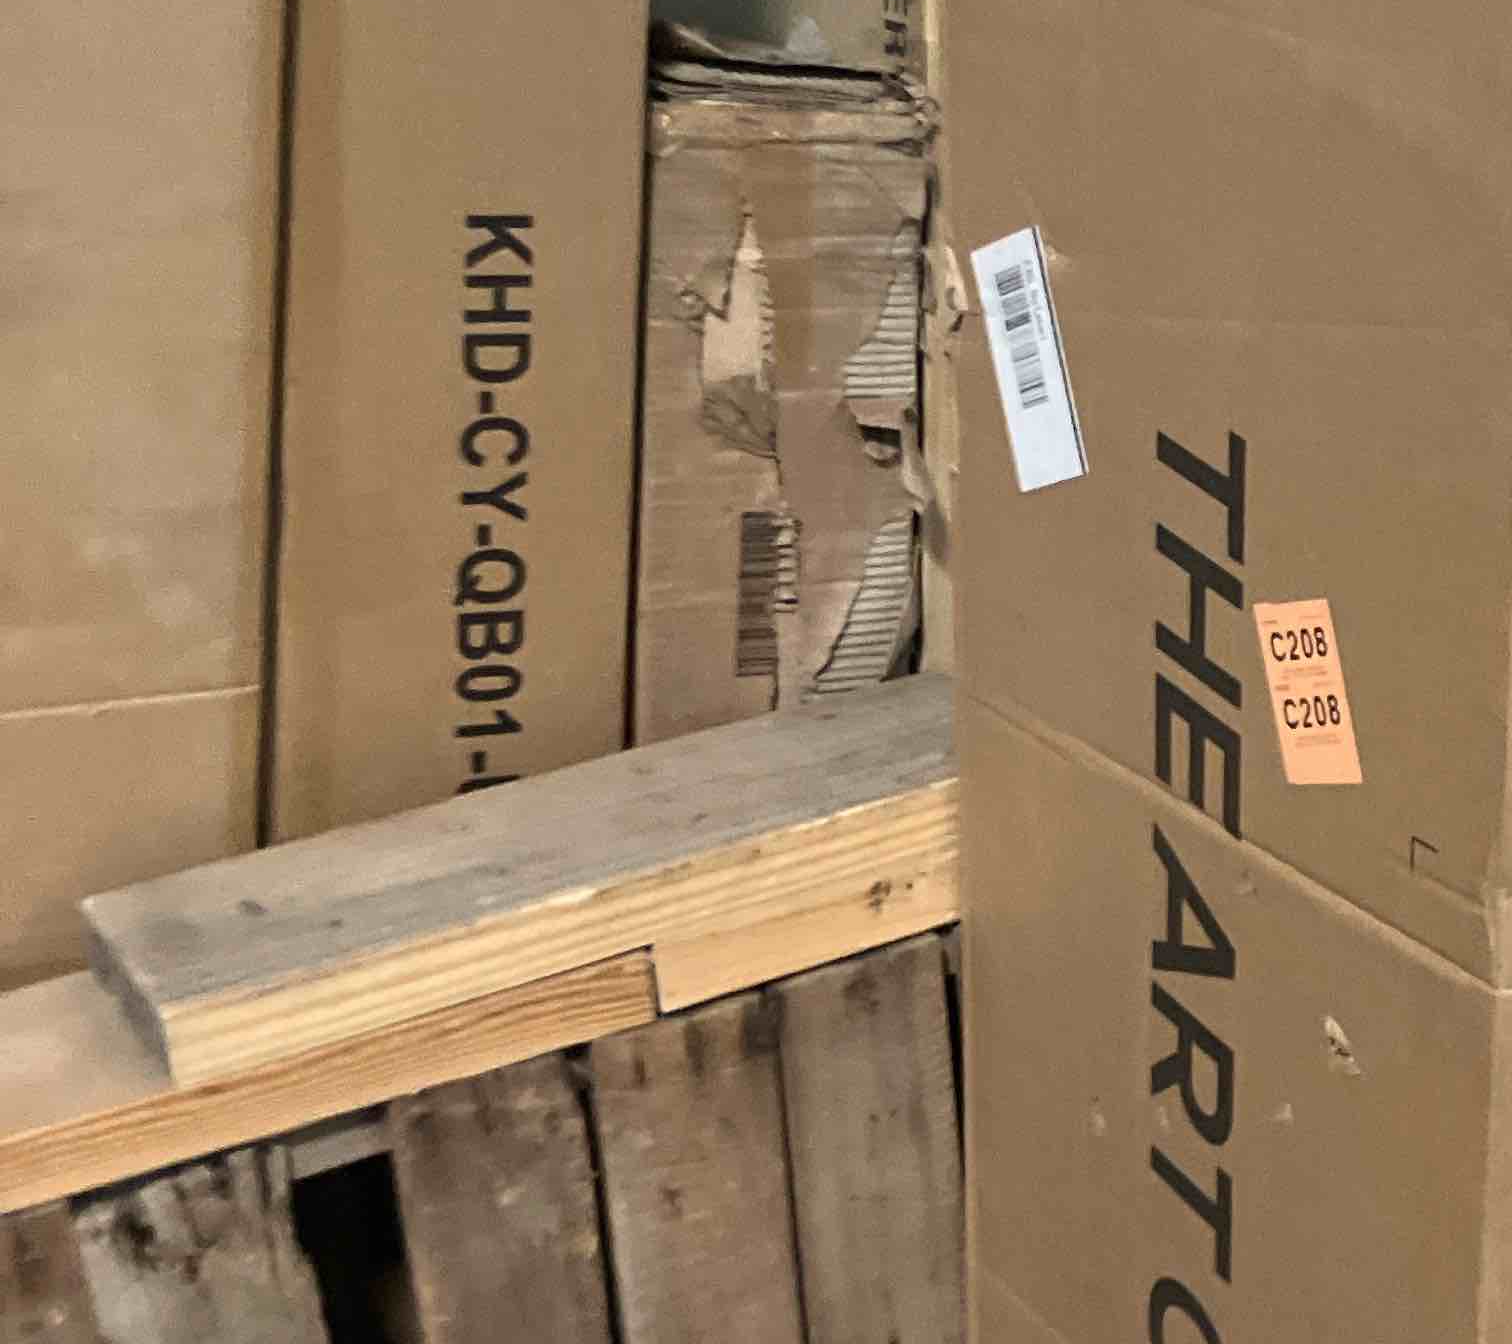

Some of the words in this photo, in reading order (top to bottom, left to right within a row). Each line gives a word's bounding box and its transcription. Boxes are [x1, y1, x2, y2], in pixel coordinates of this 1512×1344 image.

[1155, 430, 1248, 841] THE
[1270, 626, 1329, 662] C208
[1283, 695, 1342, 731] C208
[1150, 822, 1237, 1283] ART
